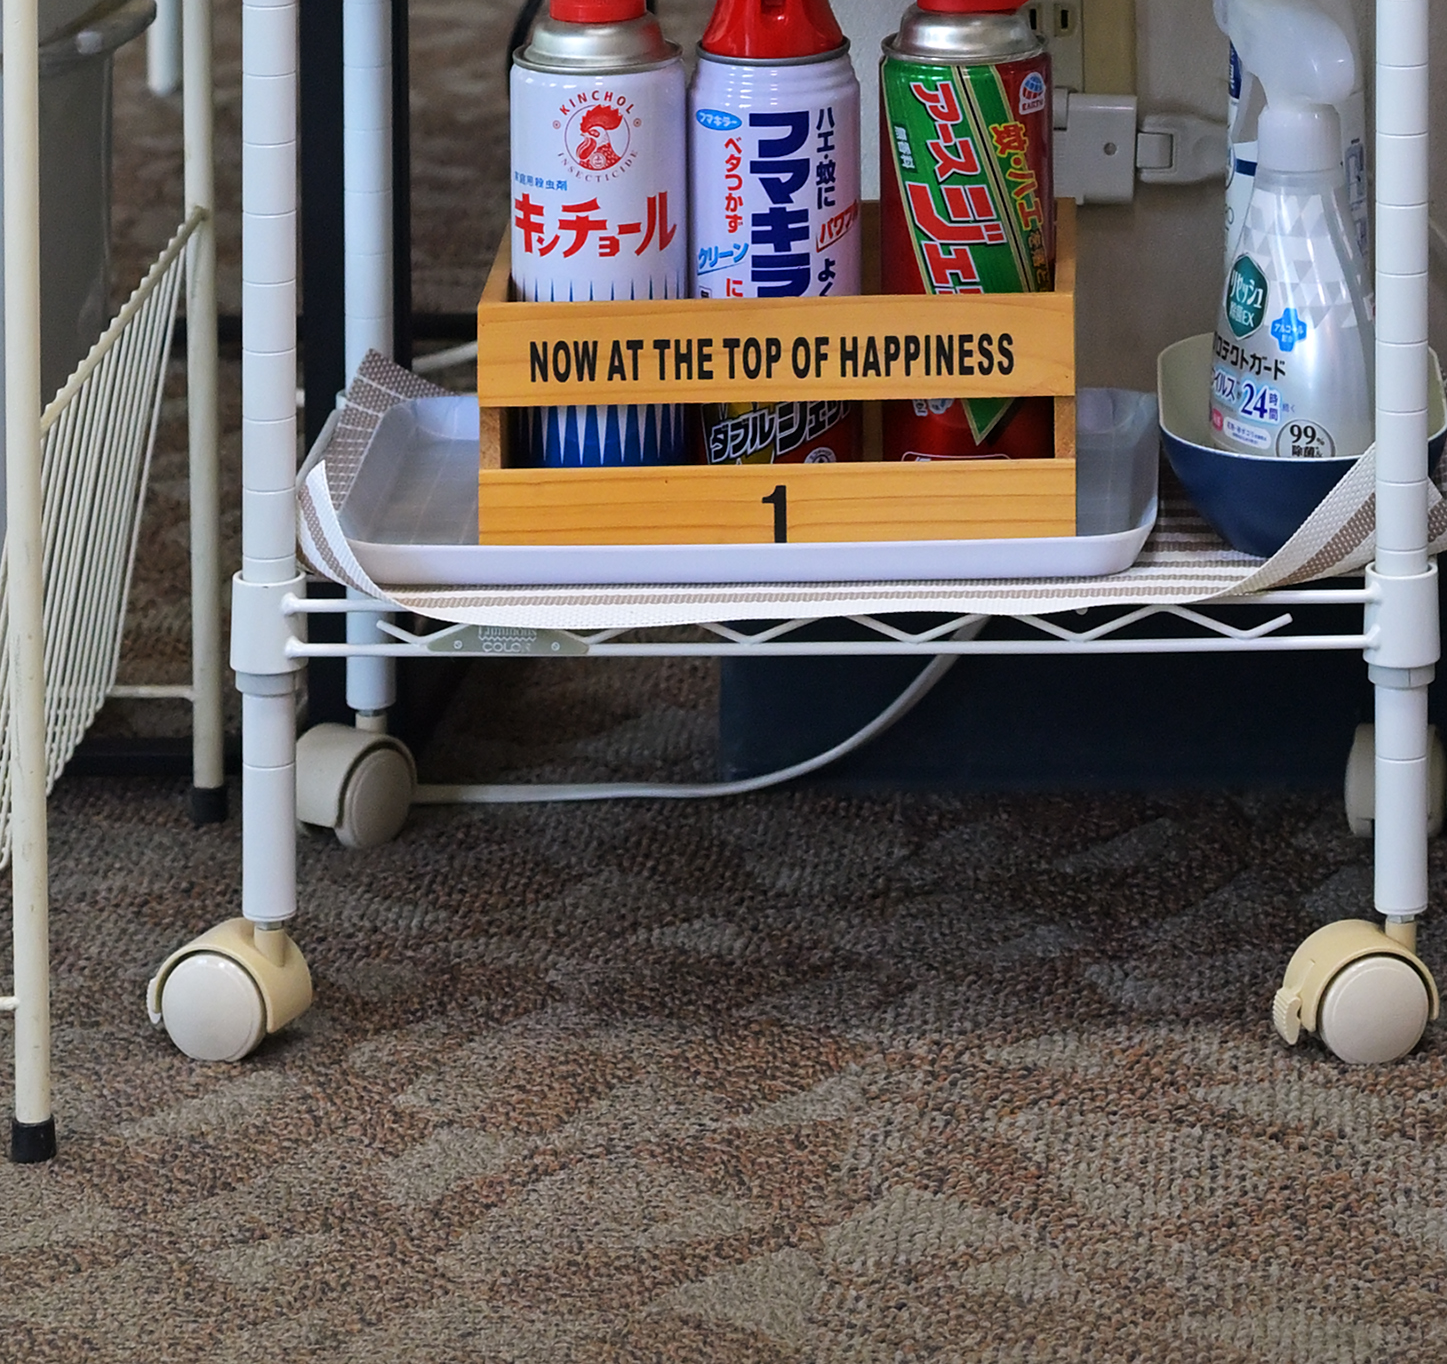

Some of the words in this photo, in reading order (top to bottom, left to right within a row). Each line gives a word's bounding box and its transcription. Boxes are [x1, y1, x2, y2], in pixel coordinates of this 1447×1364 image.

[558, 89, 637, 117] KINCHOL
[557, 148, 640, 183] INSECTICIDE
[724, 136, 744, 234] ベタつかず
[514, 191, 678, 259] キンチョール
[698, 241, 750, 271] クリーン
[529, 340, 598, 383] NOW
[608, 339, 644, 382] AT
[653, 339, 714, 381] THE
[723, 337, 782, 380] TOP
[792, 336, 829, 378] OF
[840, 333, 1015, 379] HAPPINESS
[1241, 382, 1269, 419] 24
[761, 484, 788, 544] 1
